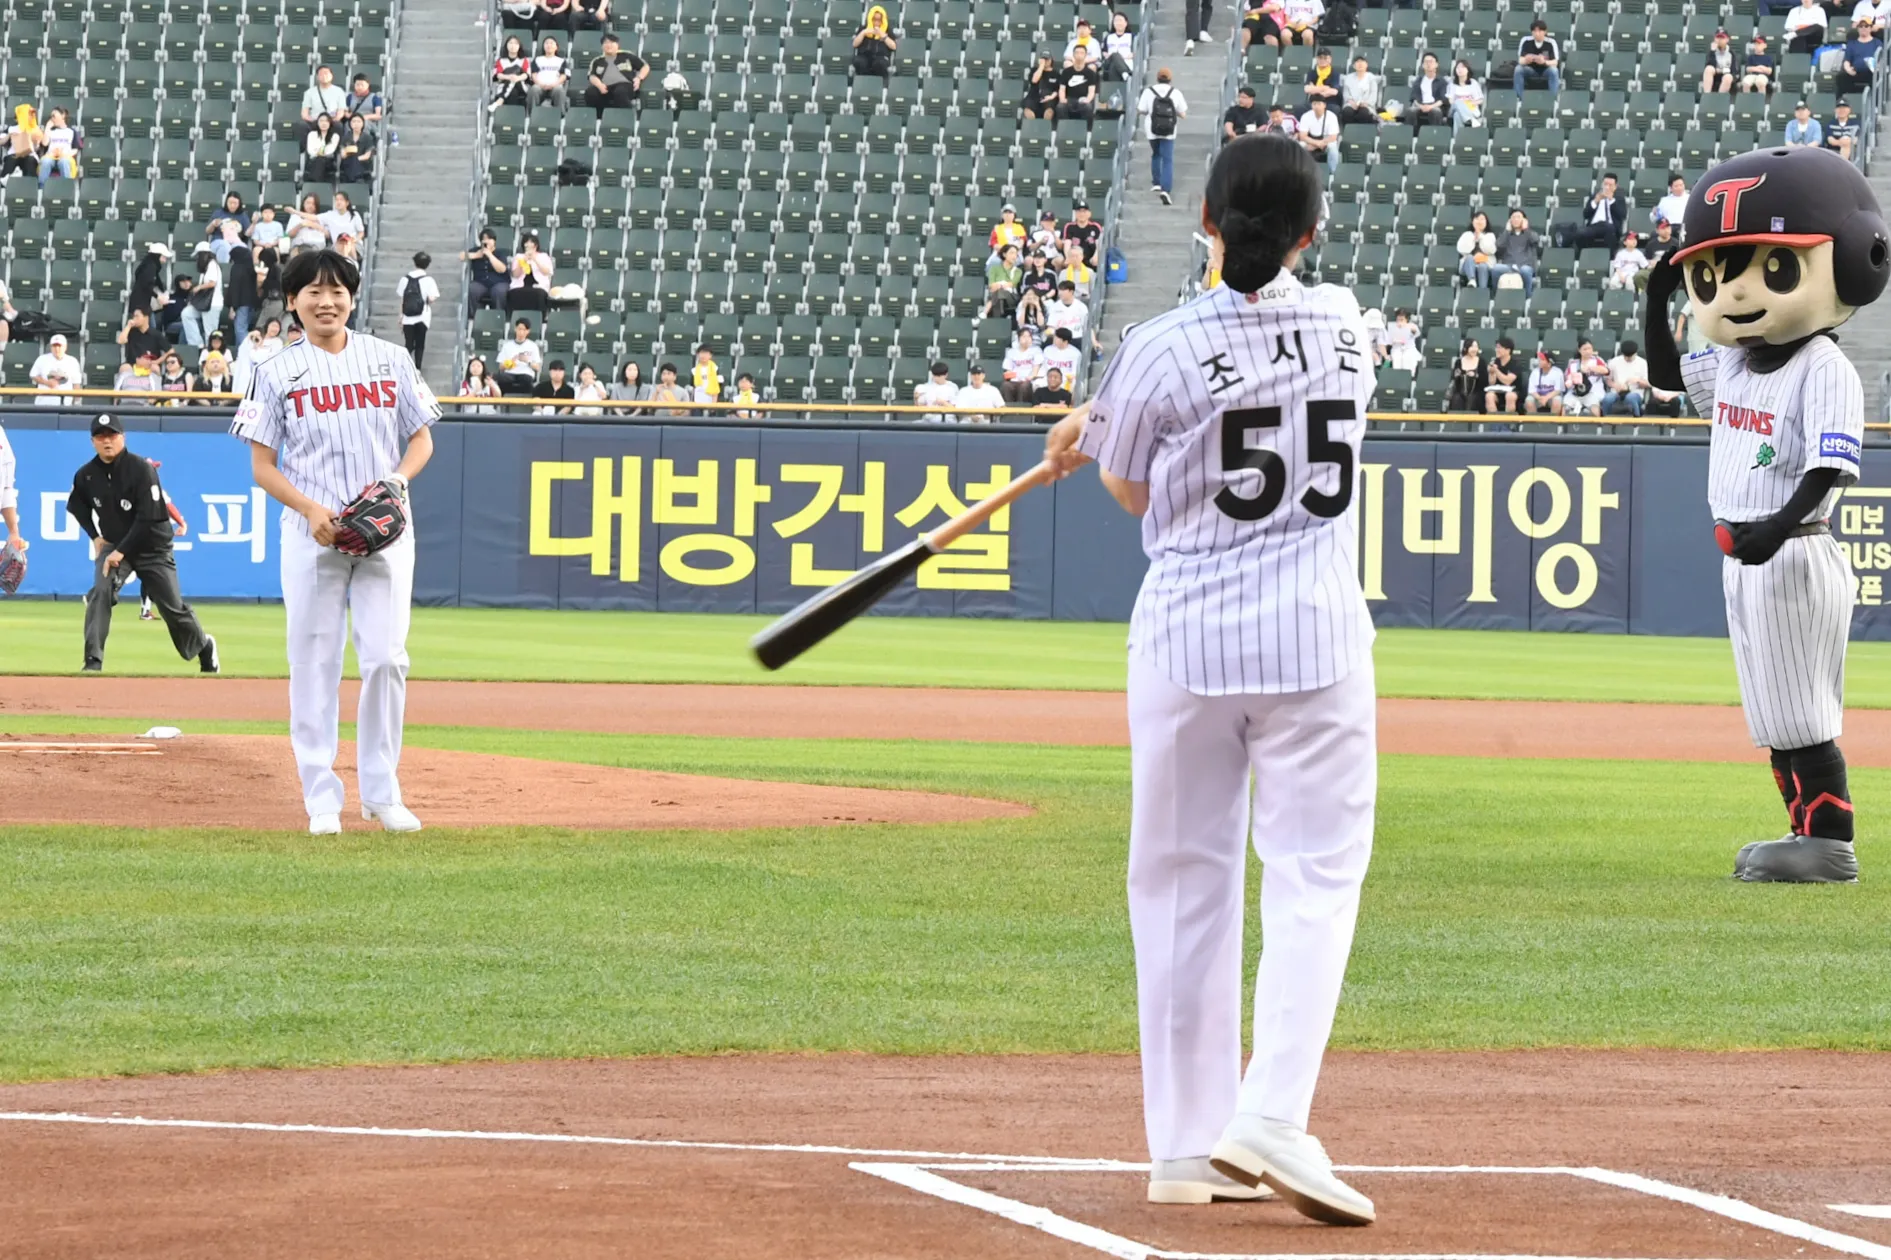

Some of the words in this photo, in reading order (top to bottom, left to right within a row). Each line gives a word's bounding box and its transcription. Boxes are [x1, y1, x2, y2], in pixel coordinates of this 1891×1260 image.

[1704, 172, 1767, 233] T
[367, 363, 391, 378] LG
[286, 380, 397, 418] TWINS
[1717, 401, 1775, 437] TWINS
[1213, 399, 1356, 522] 55
[1821, 437, 1861, 458] 신한카드
[529, 455, 1012, 591] 대방건설
